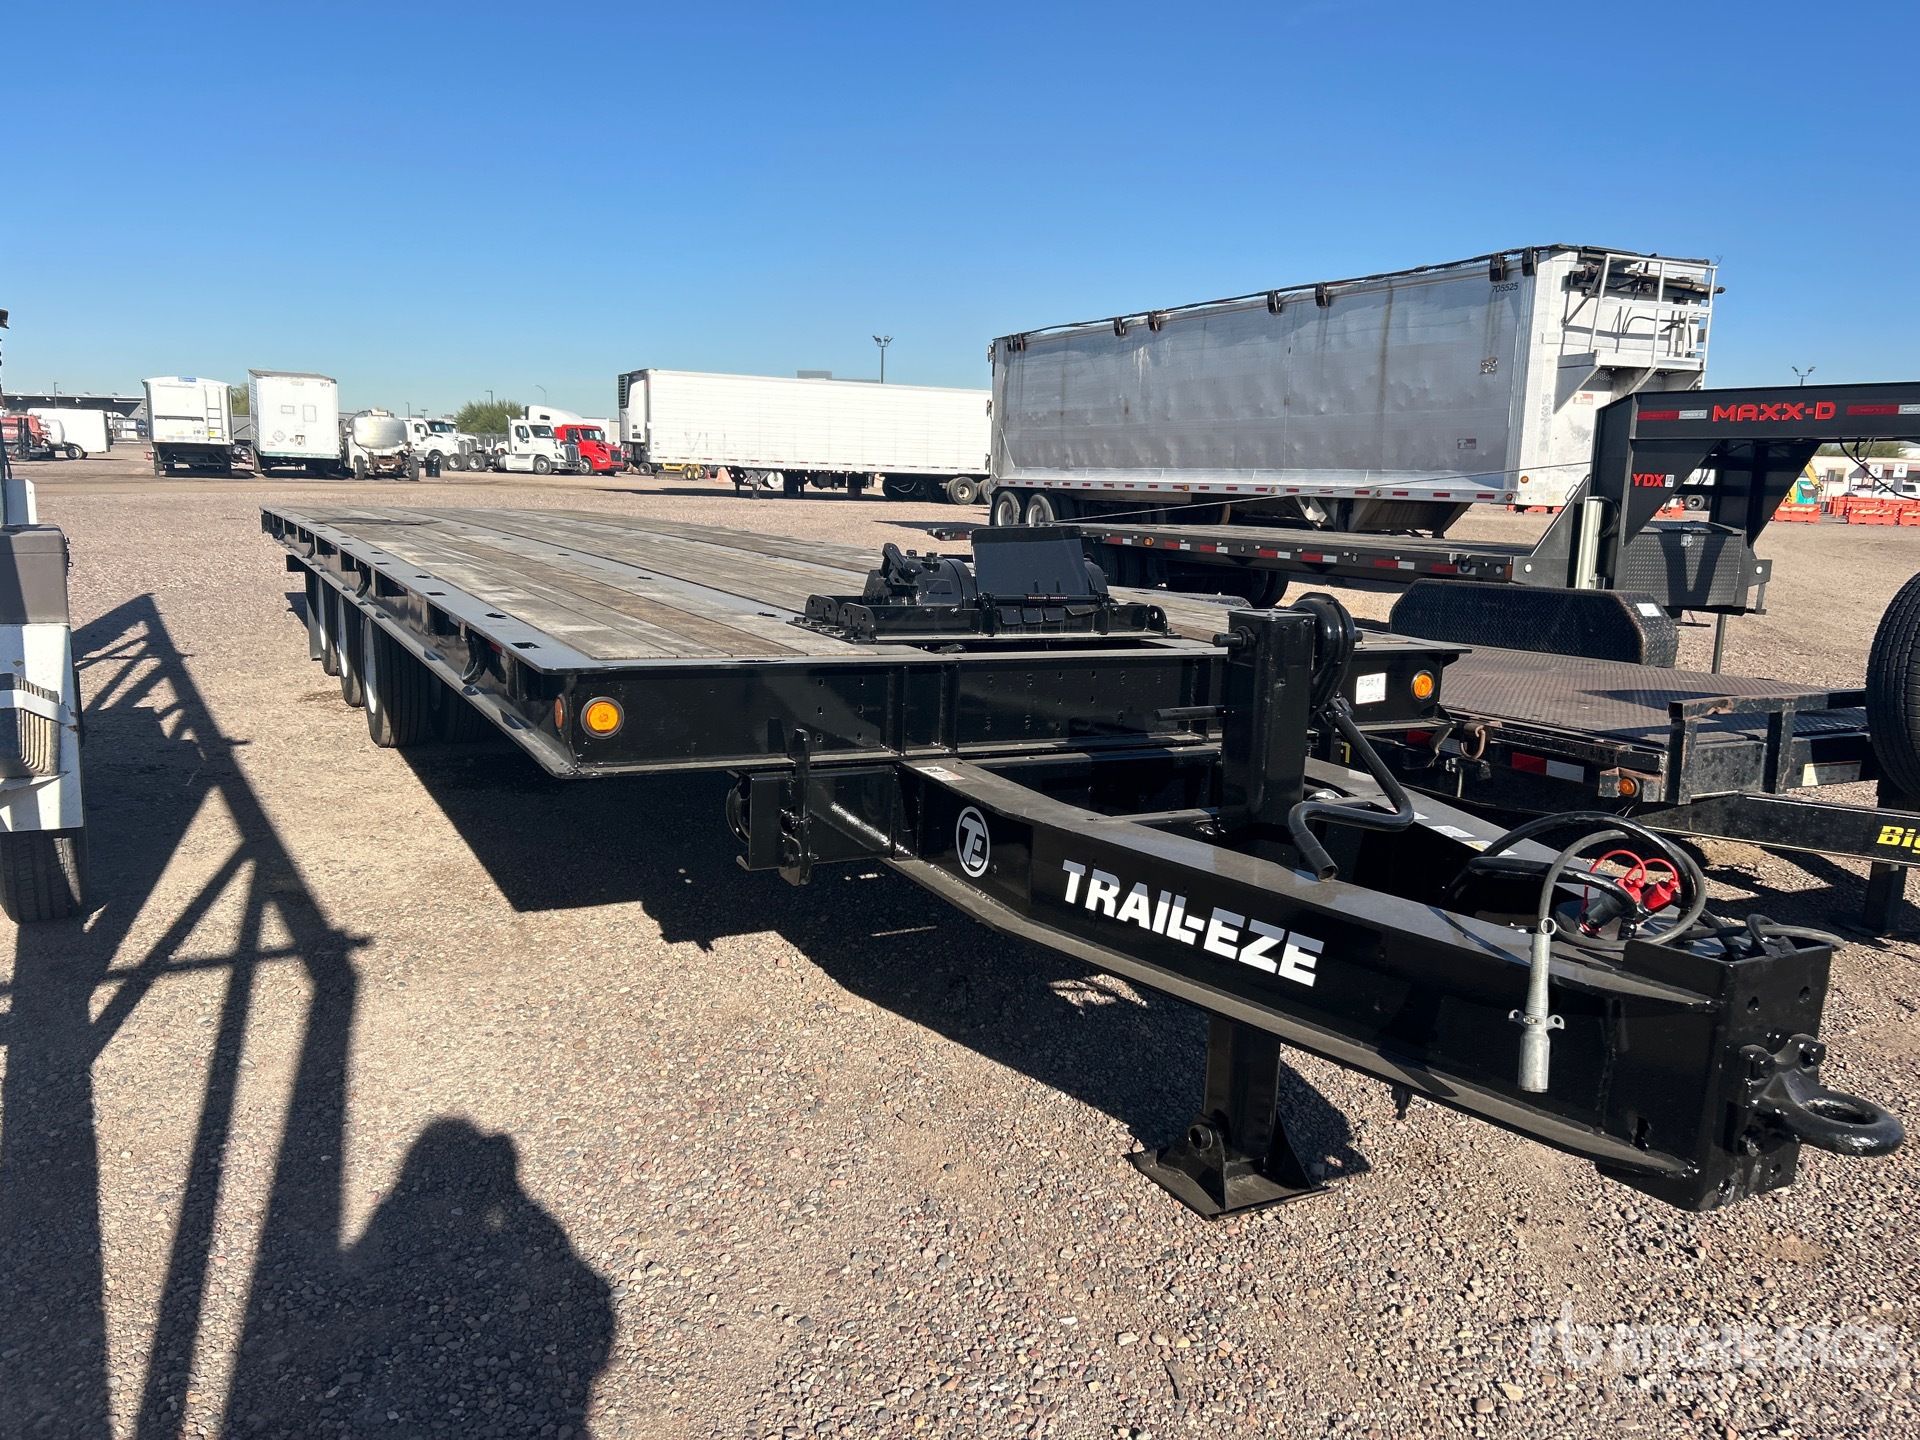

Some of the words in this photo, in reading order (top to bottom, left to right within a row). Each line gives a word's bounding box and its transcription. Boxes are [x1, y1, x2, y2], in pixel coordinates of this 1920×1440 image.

[1492, 282, 1519, 293] 705525
[1712, 401, 1837, 422] MAXX-D
[1632, 473, 1665, 487] YDX
[1062, 859, 1325, 987] TRAIL-EZE
